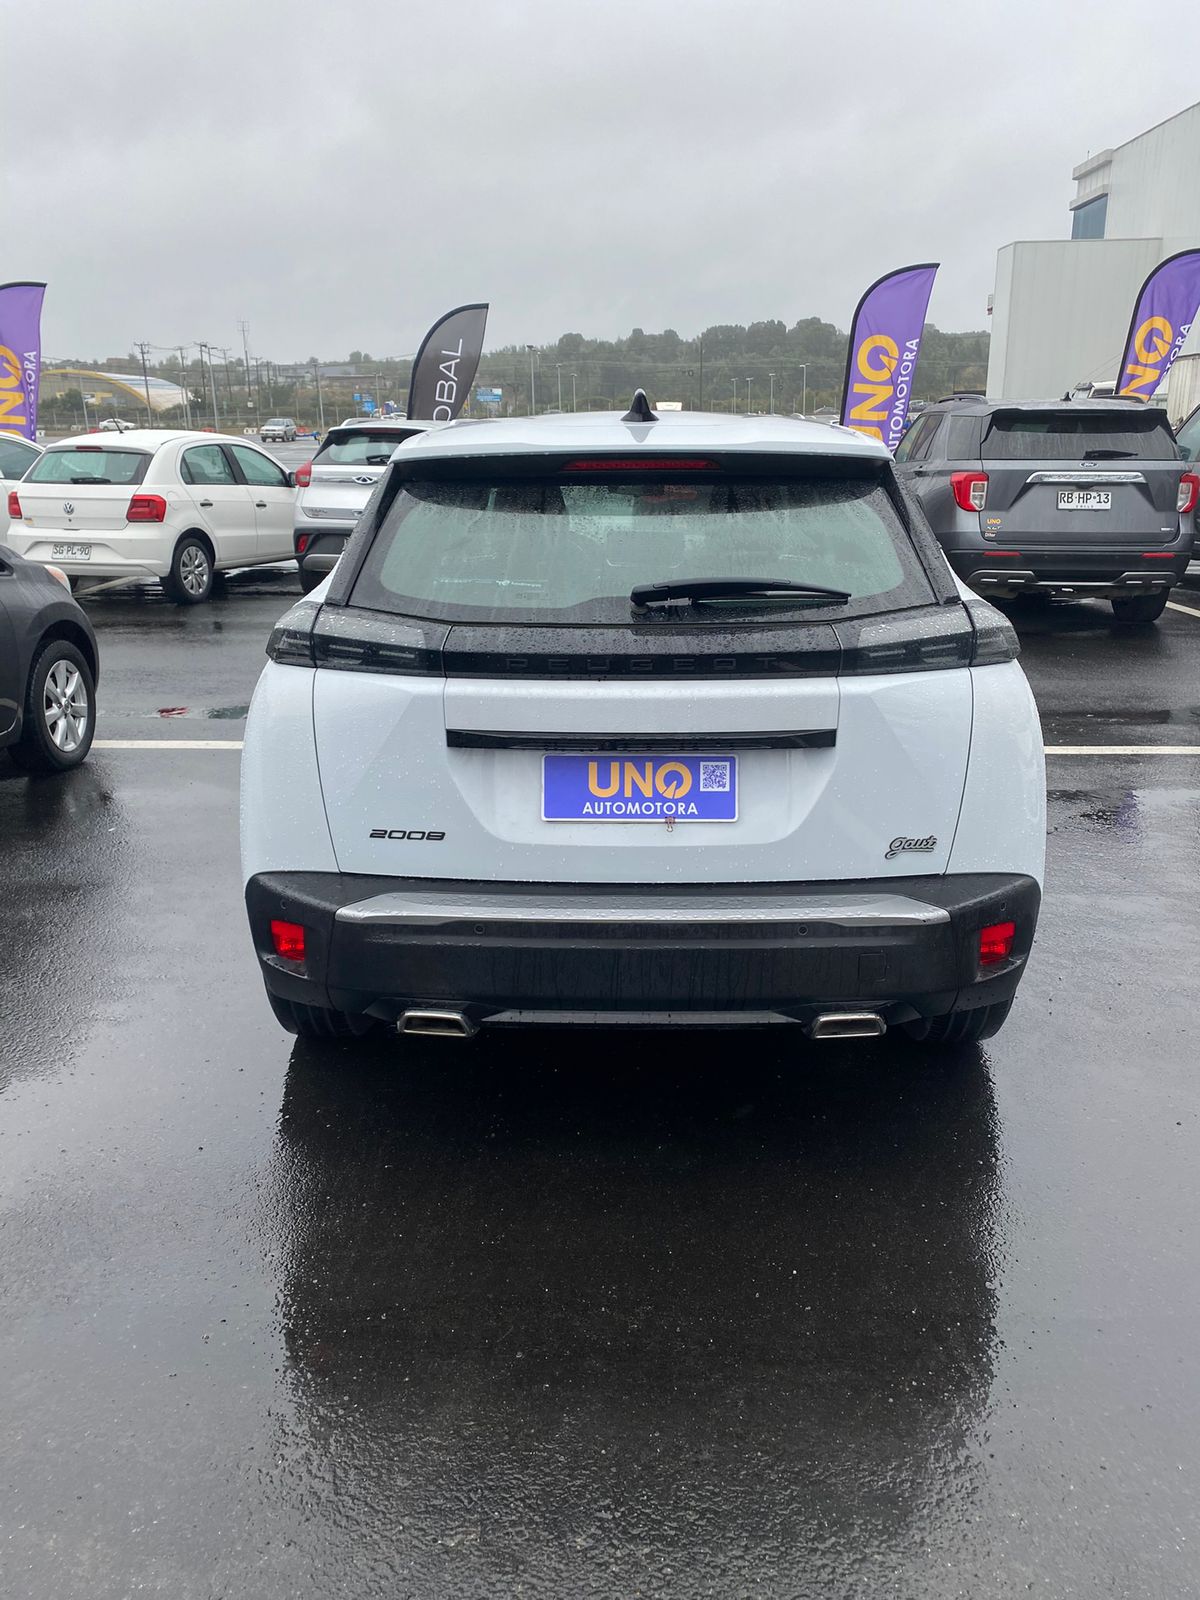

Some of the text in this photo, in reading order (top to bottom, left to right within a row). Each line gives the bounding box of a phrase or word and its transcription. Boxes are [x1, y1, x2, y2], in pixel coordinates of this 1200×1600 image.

[506, 658, 777, 671] PEUGEOT
[588, 761, 693, 799] UNO
[582, 801, 698, 815] AUTOMOTORA
[369, 829, 446, 841] 2008
